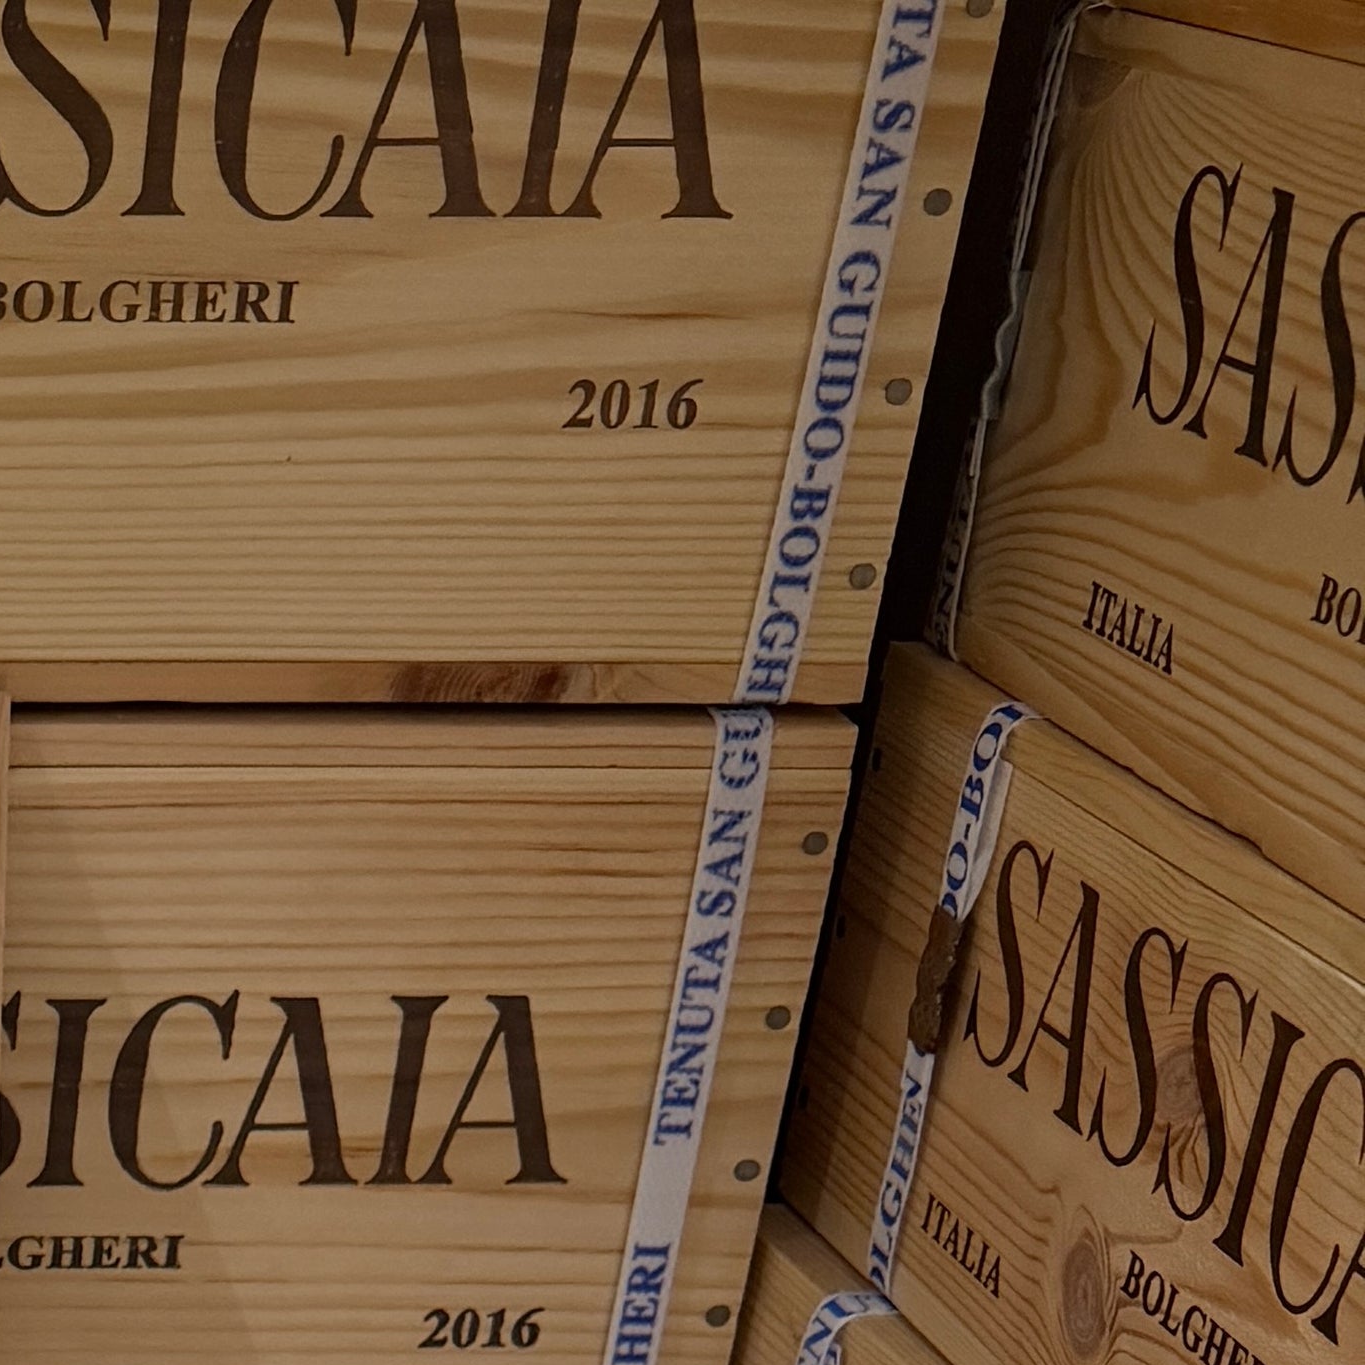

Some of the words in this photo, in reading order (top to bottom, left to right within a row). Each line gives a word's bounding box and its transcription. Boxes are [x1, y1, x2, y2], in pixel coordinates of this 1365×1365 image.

[847, 95, 917, 233] SAN
[1132, 162, 1365, 505] SAS
[561, 377, 704, 432] 2016
[1082, 580, 1175, 675] ITALIA
[653, 927, 730, 1146] TENUTA
[697, 806, 752, 918] SAN
[920, 1191, 1002, 1299] ITALIA
[417, 1305, 546, 1351] 2016
